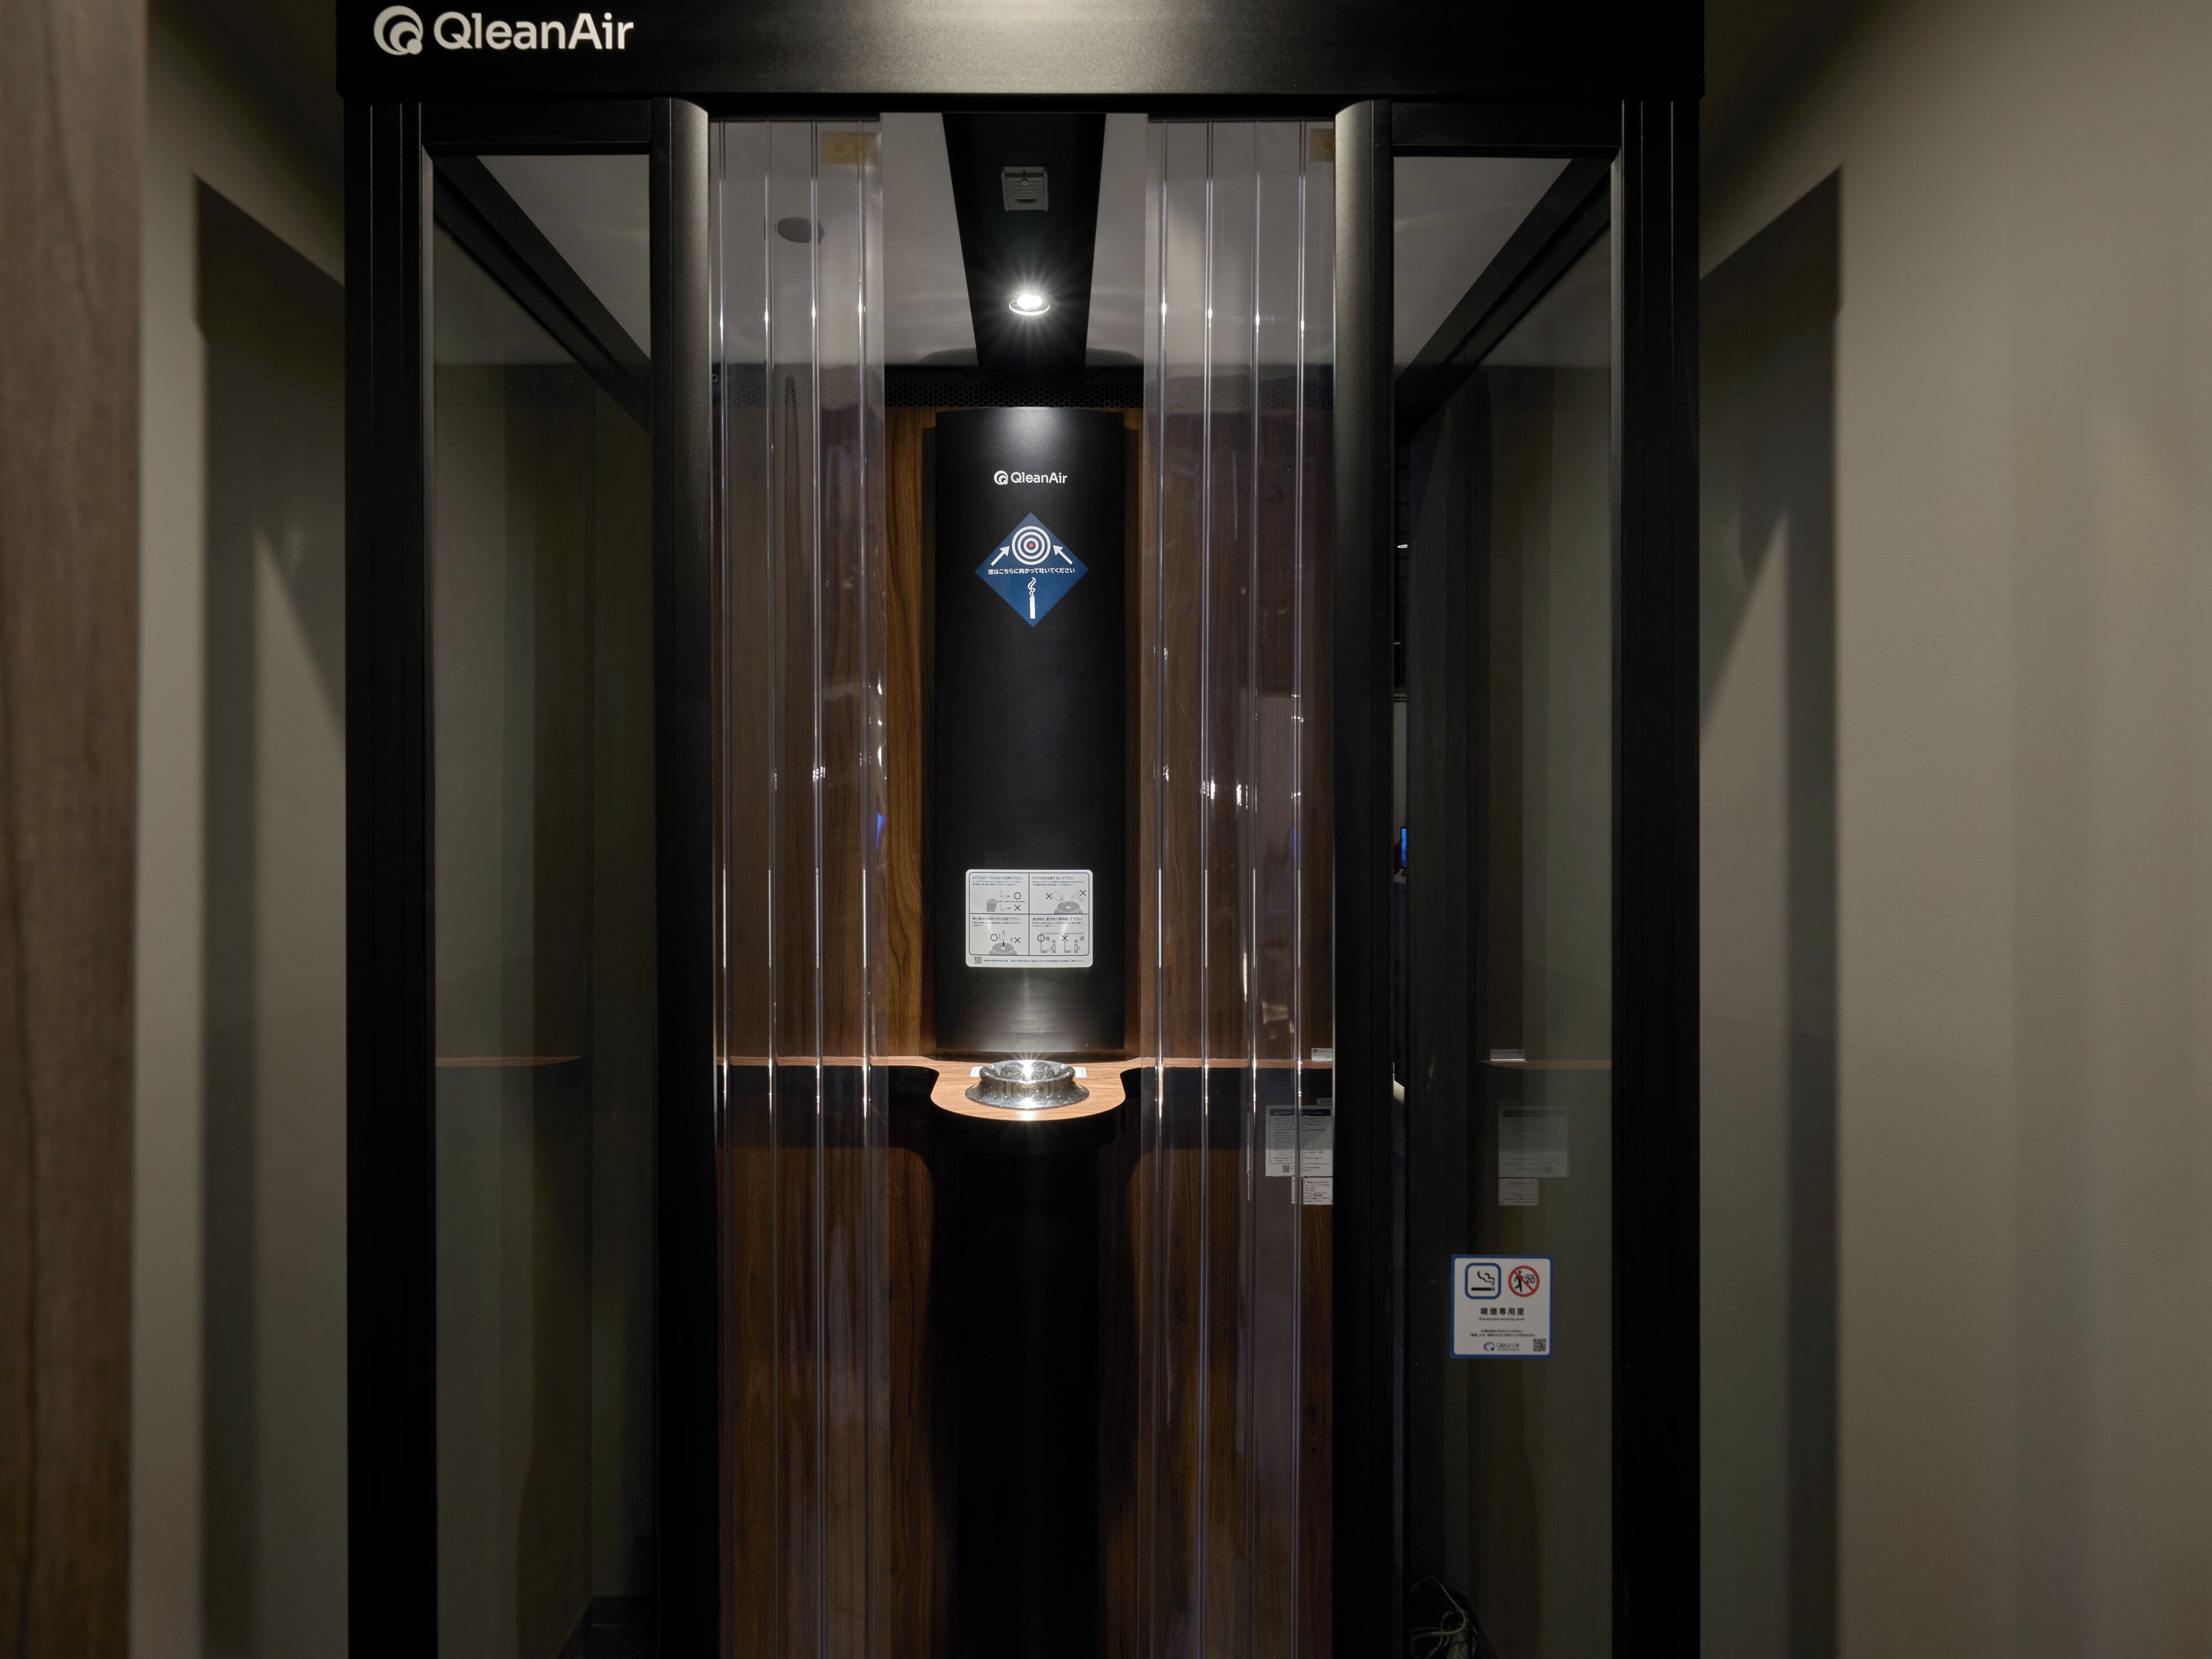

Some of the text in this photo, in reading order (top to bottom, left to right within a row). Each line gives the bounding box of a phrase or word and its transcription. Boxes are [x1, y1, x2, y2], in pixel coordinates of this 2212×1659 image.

[433, 10, 634, 50] QleanAir
[1010, 471, 1068, 484] QleanAir
[1525, 1276, 1535, 1284] 20
